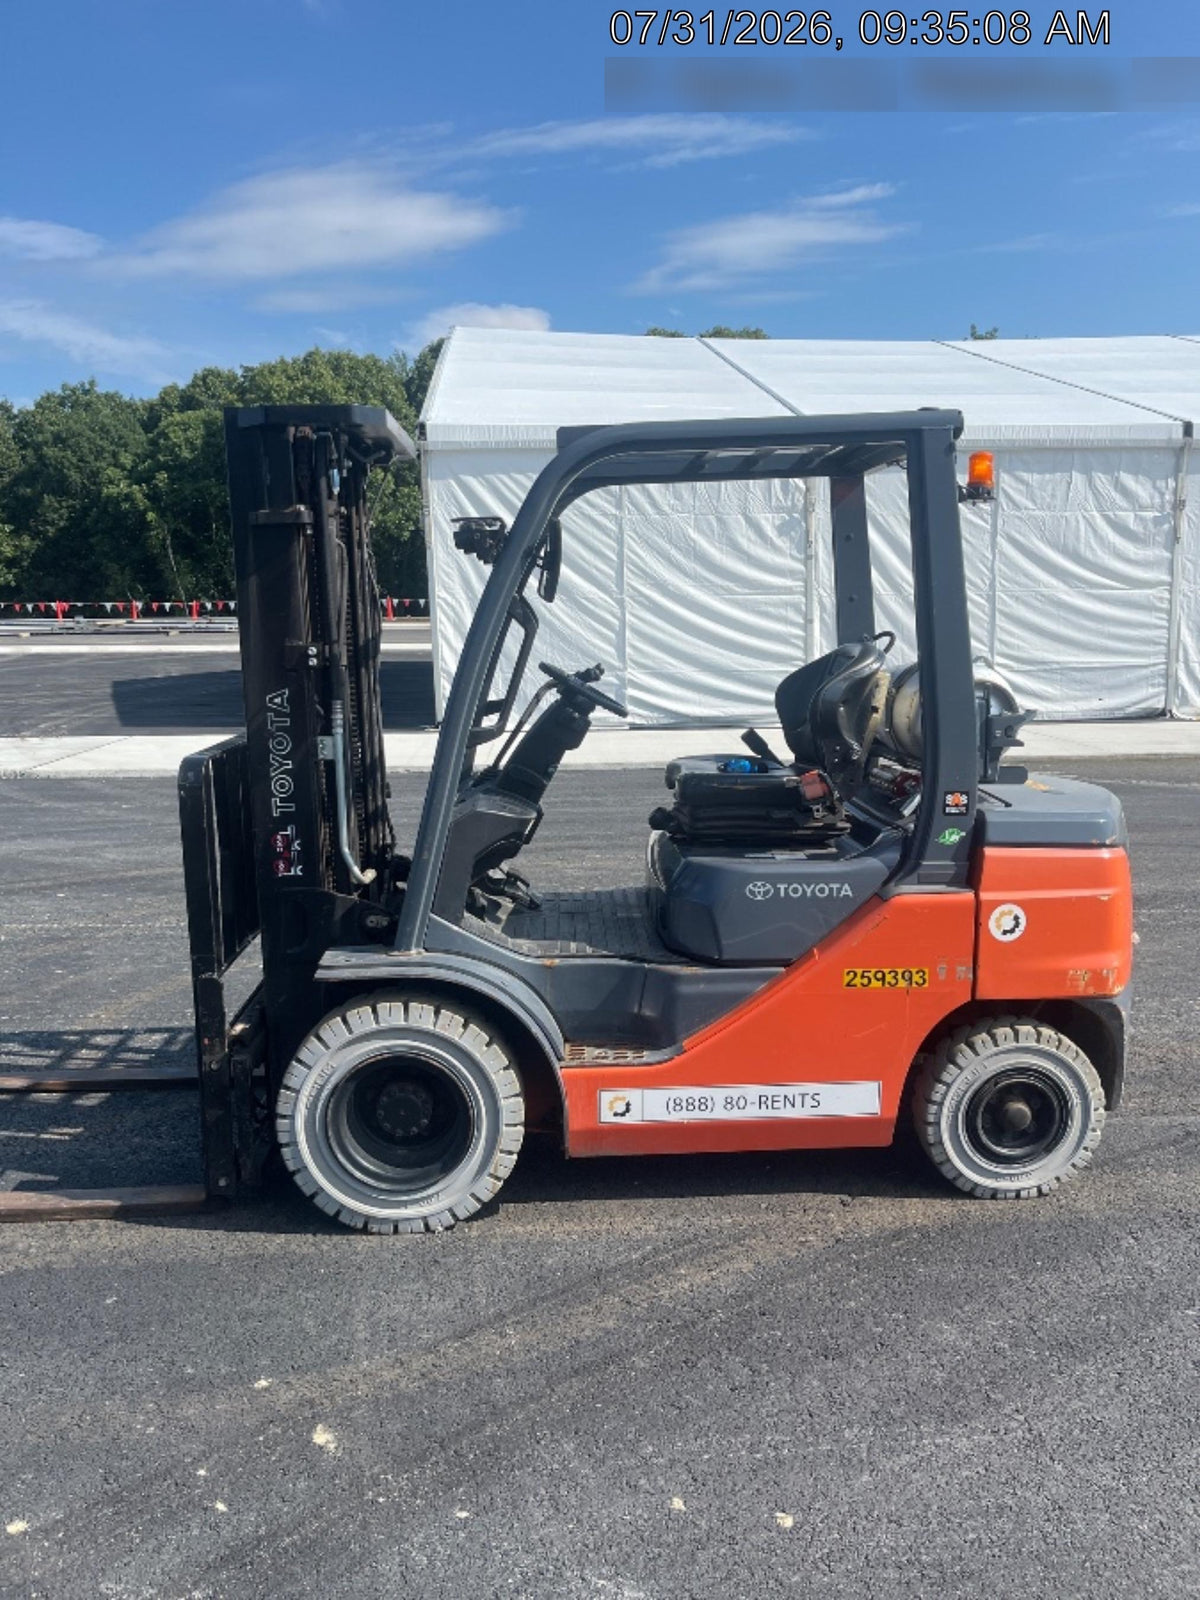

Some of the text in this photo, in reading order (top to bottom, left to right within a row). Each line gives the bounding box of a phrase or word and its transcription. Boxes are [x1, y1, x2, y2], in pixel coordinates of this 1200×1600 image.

[266, 688, 295, 817] TOYOTA
[777, 883, 853, 898] TOYOTA
[844, 969, 928, 988] 259393
[665, 1092, 821, 1115] (888) 80-RENTS
